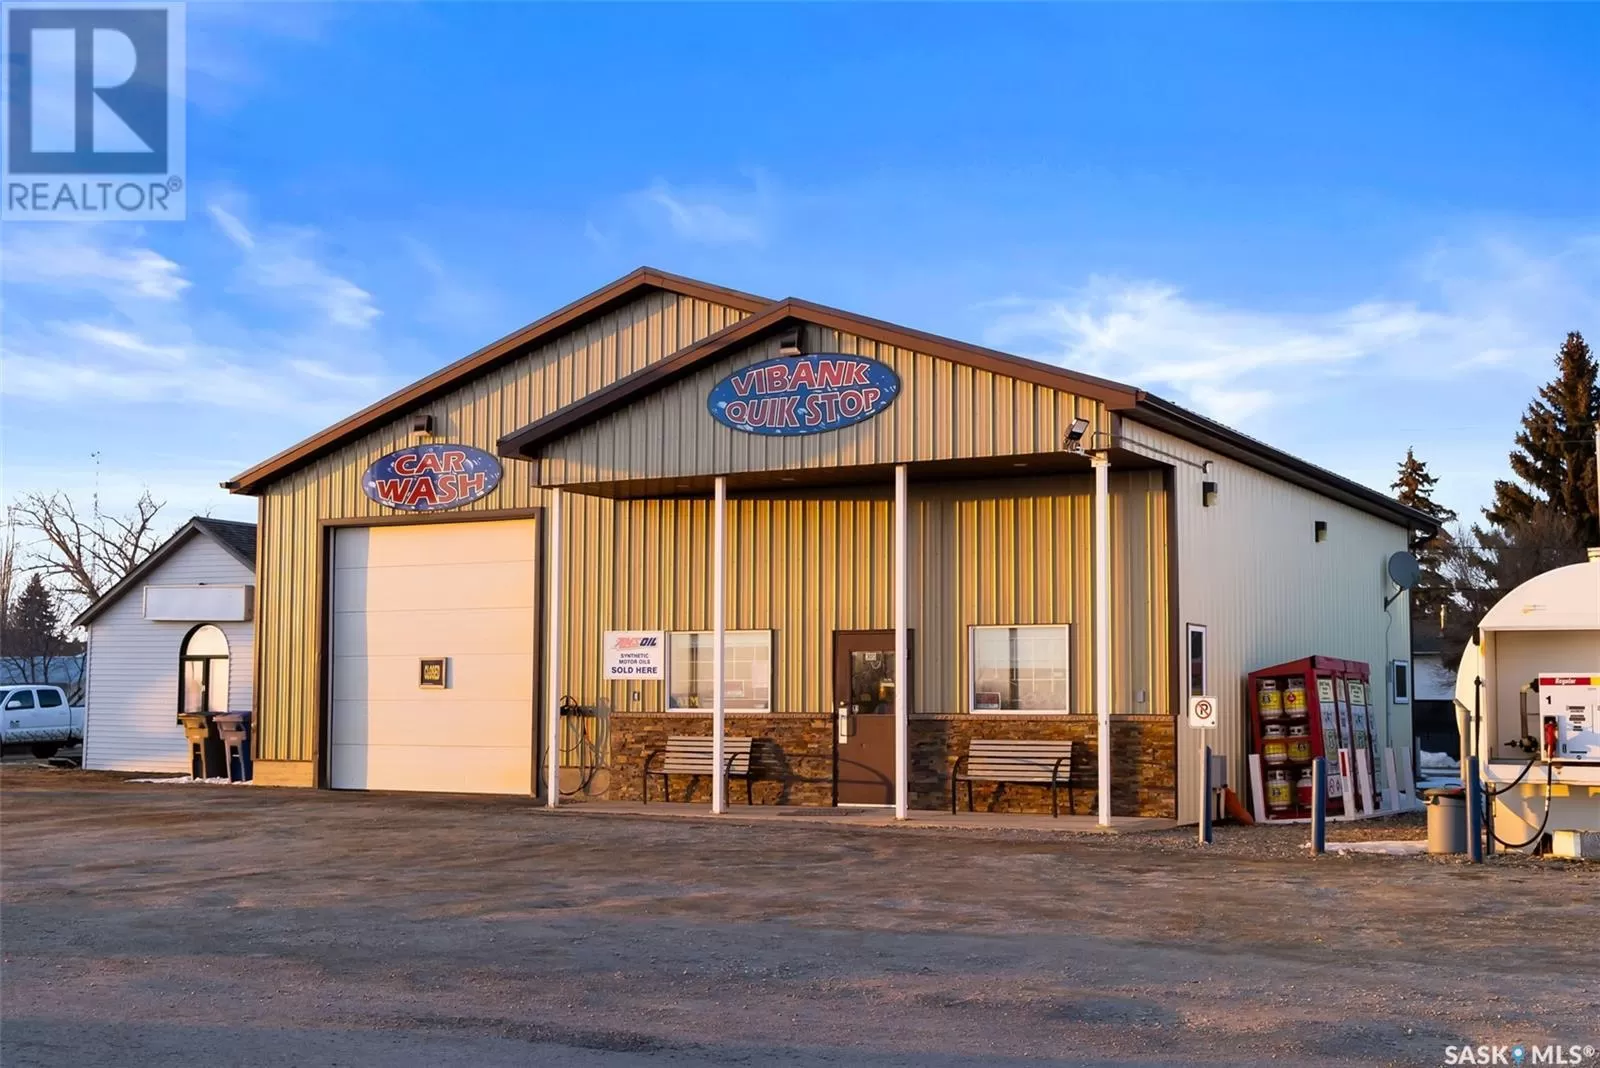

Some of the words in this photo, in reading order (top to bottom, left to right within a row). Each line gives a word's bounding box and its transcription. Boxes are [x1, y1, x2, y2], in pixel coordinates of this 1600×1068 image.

[731, 360, 871, 397] VIBANK
[725, 395, 800, 428] QUIK
[805, 388, 881, 426] STOP
[394, 450, 466, 477] CAR
[375, 471, 486, 506] WASH
[611, 666, 634, 674] SOLD
[635, 666, 658, 674] HERE
[1545, 695, 1552, 705] 1
